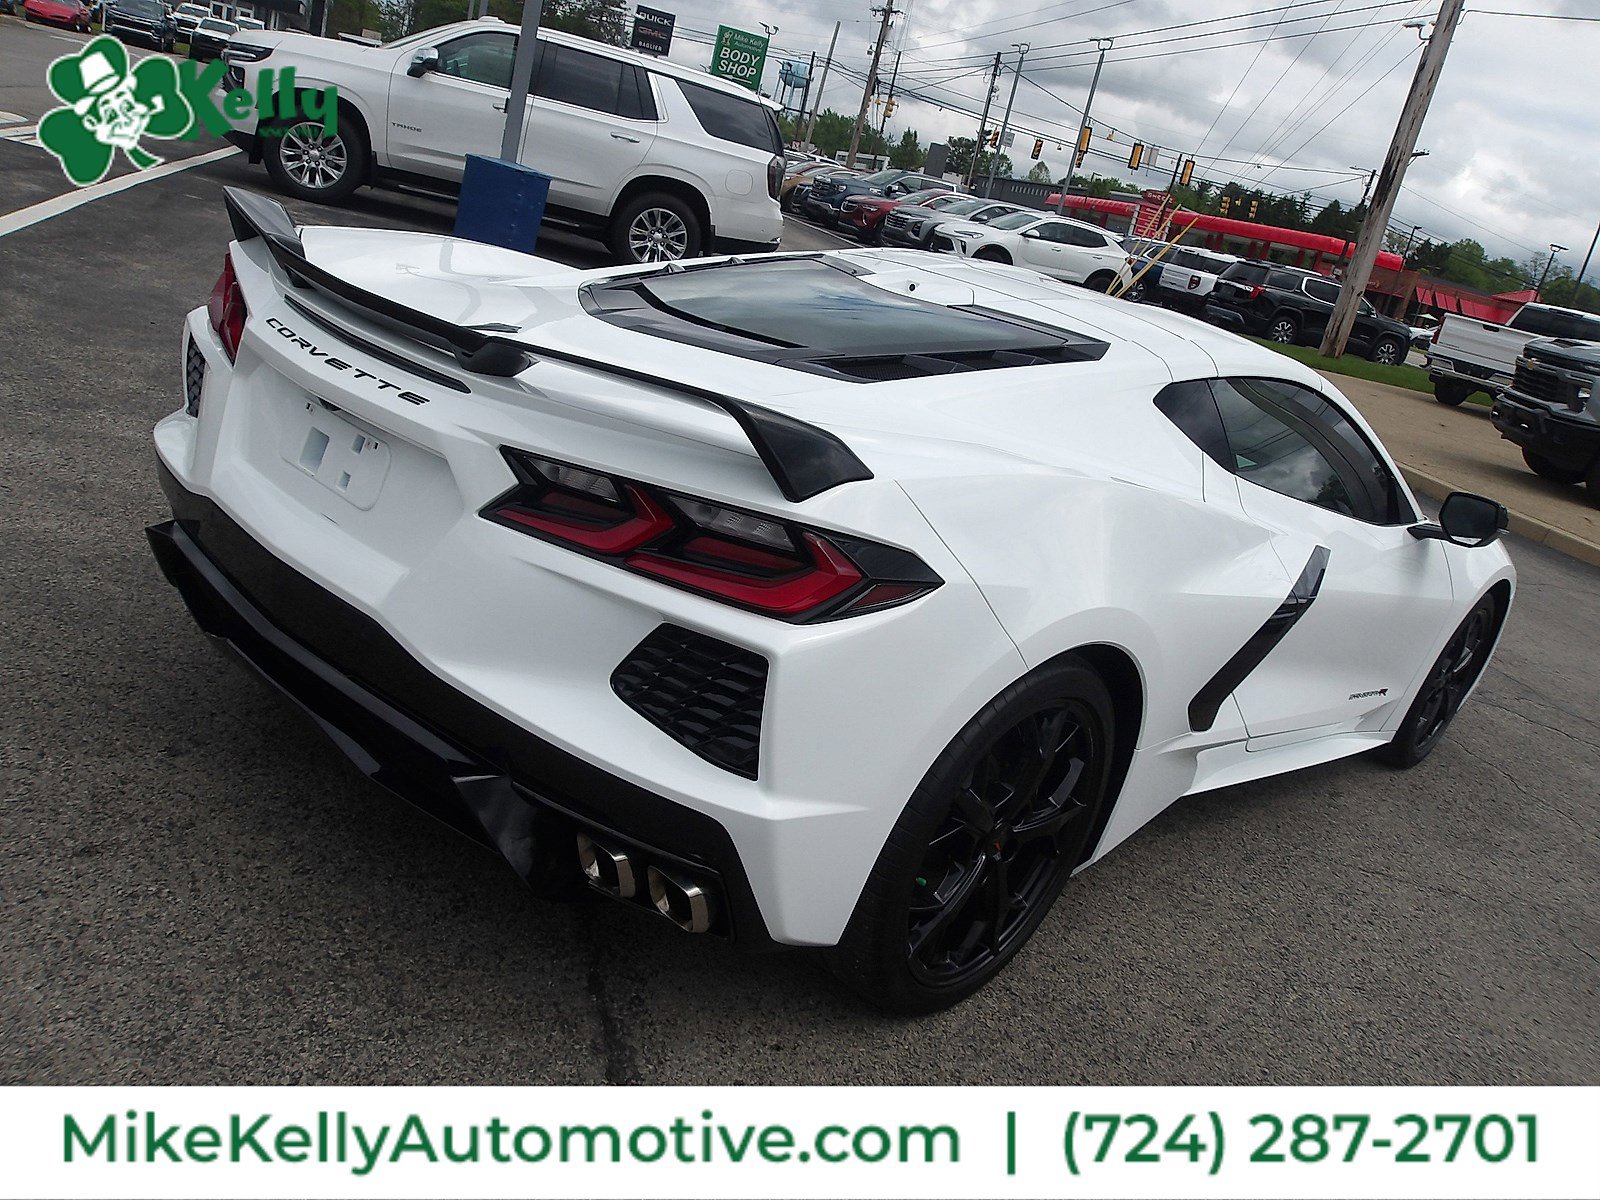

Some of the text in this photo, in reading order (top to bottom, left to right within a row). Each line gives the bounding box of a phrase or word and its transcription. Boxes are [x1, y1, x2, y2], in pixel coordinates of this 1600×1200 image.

[638, 26, 668, 40] GMC
[733, 33, 765, 49] Mike Kelly
[720, 46, 760, 67] BODY
[718, 60, 757, 78] SHOP
[391, 121, 422, 133] TAHOE
[265, 317, 431, 406] CORVETTE
